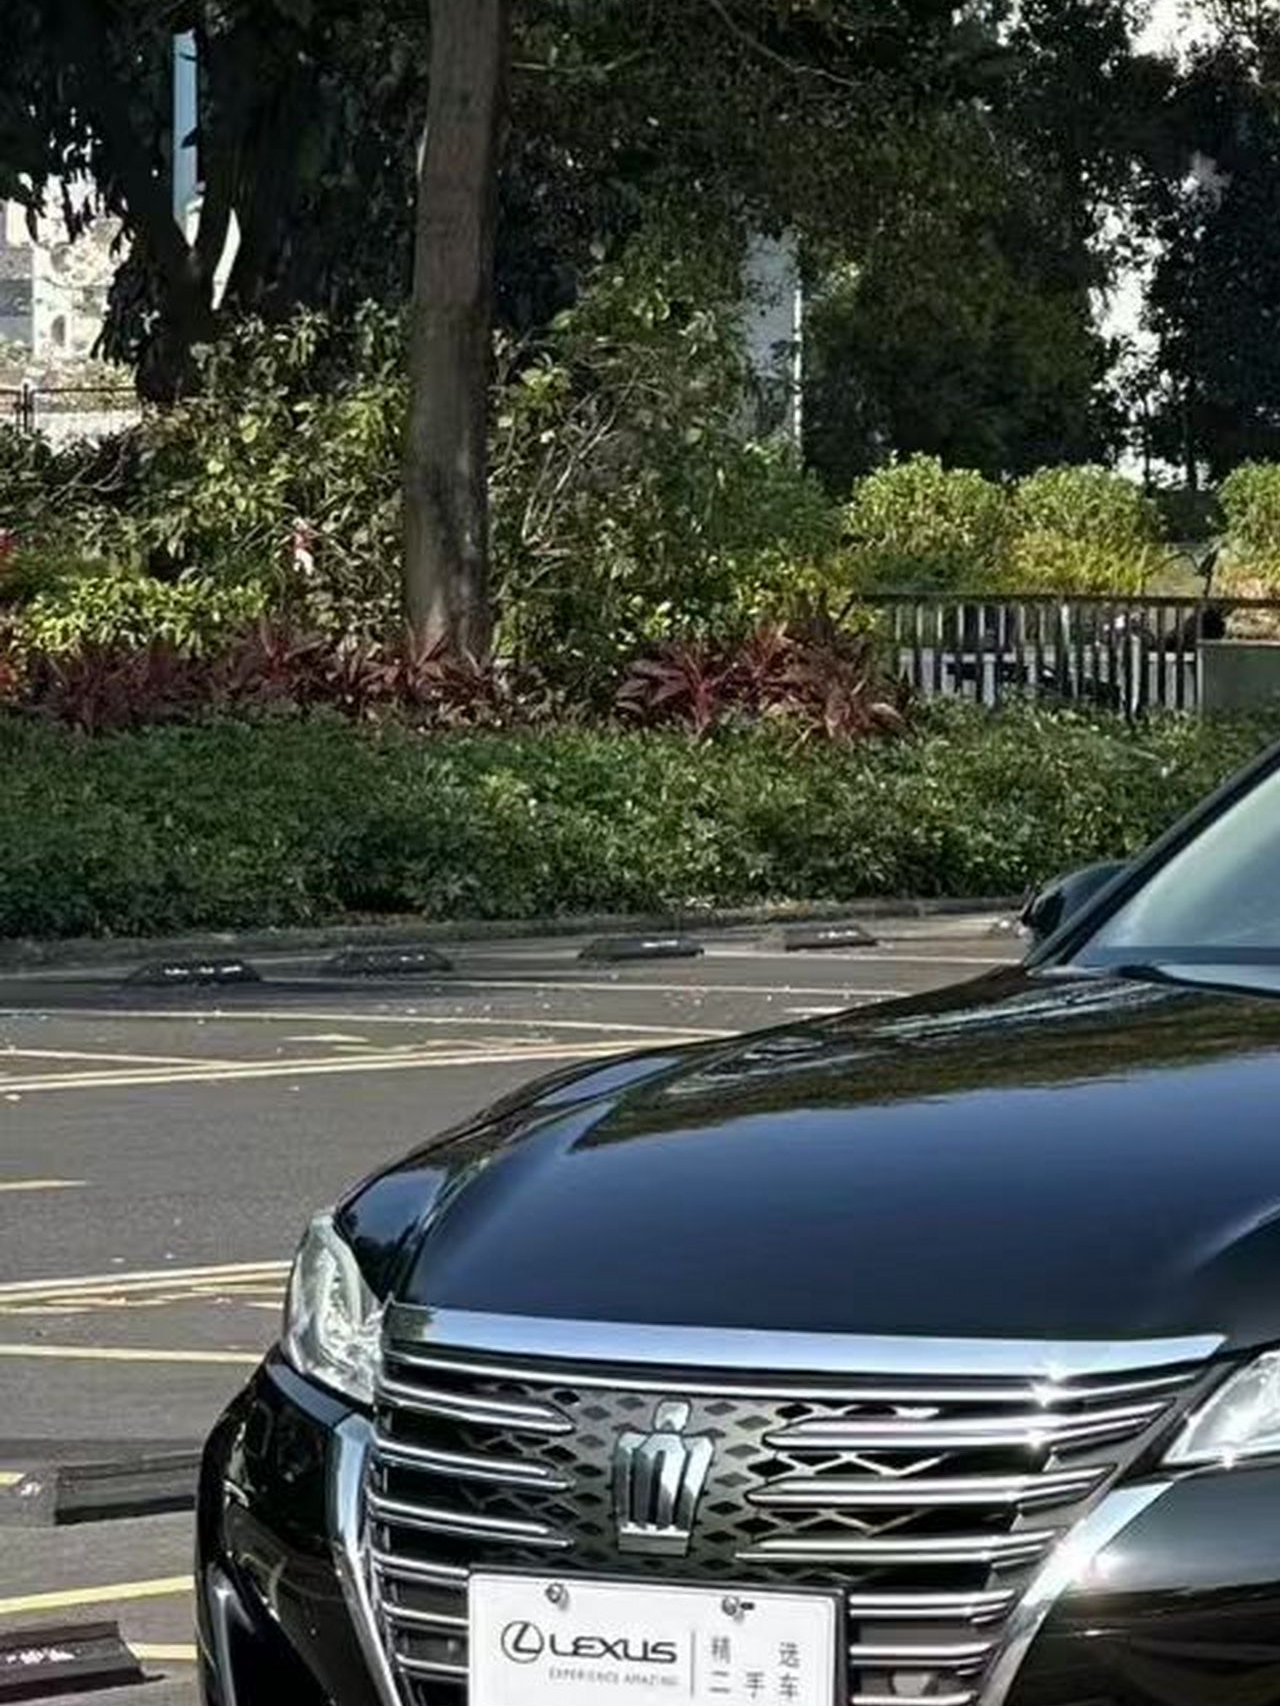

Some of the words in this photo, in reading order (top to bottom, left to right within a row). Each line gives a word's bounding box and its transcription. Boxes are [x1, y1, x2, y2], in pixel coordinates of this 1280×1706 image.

[549, 1633, 679, 1664] LEXUS
[708, 1670, 800, 1699] 二手车
